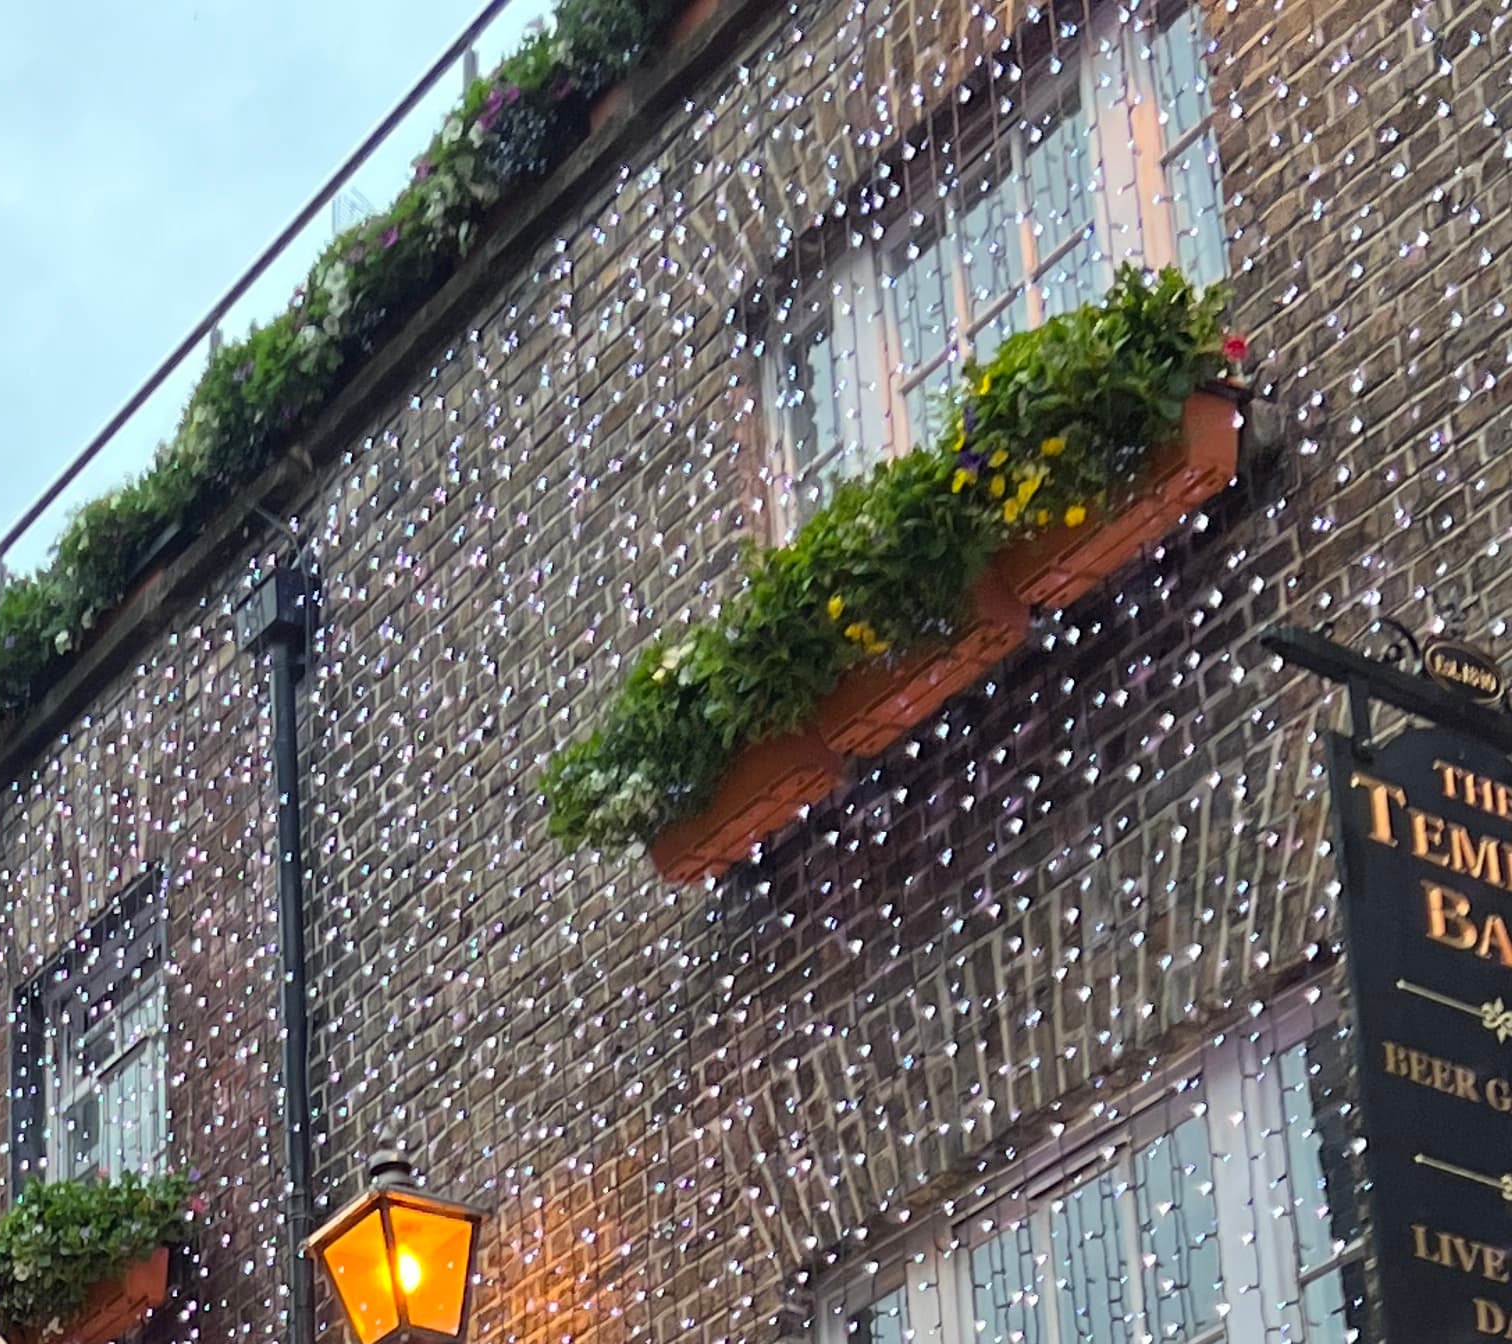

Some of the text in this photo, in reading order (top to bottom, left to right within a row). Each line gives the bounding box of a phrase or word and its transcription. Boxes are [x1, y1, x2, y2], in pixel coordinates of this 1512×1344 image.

[1381, 1040, 1512, 1113] BEER G
[1410, 1223, 1510, 1284] LIVE
